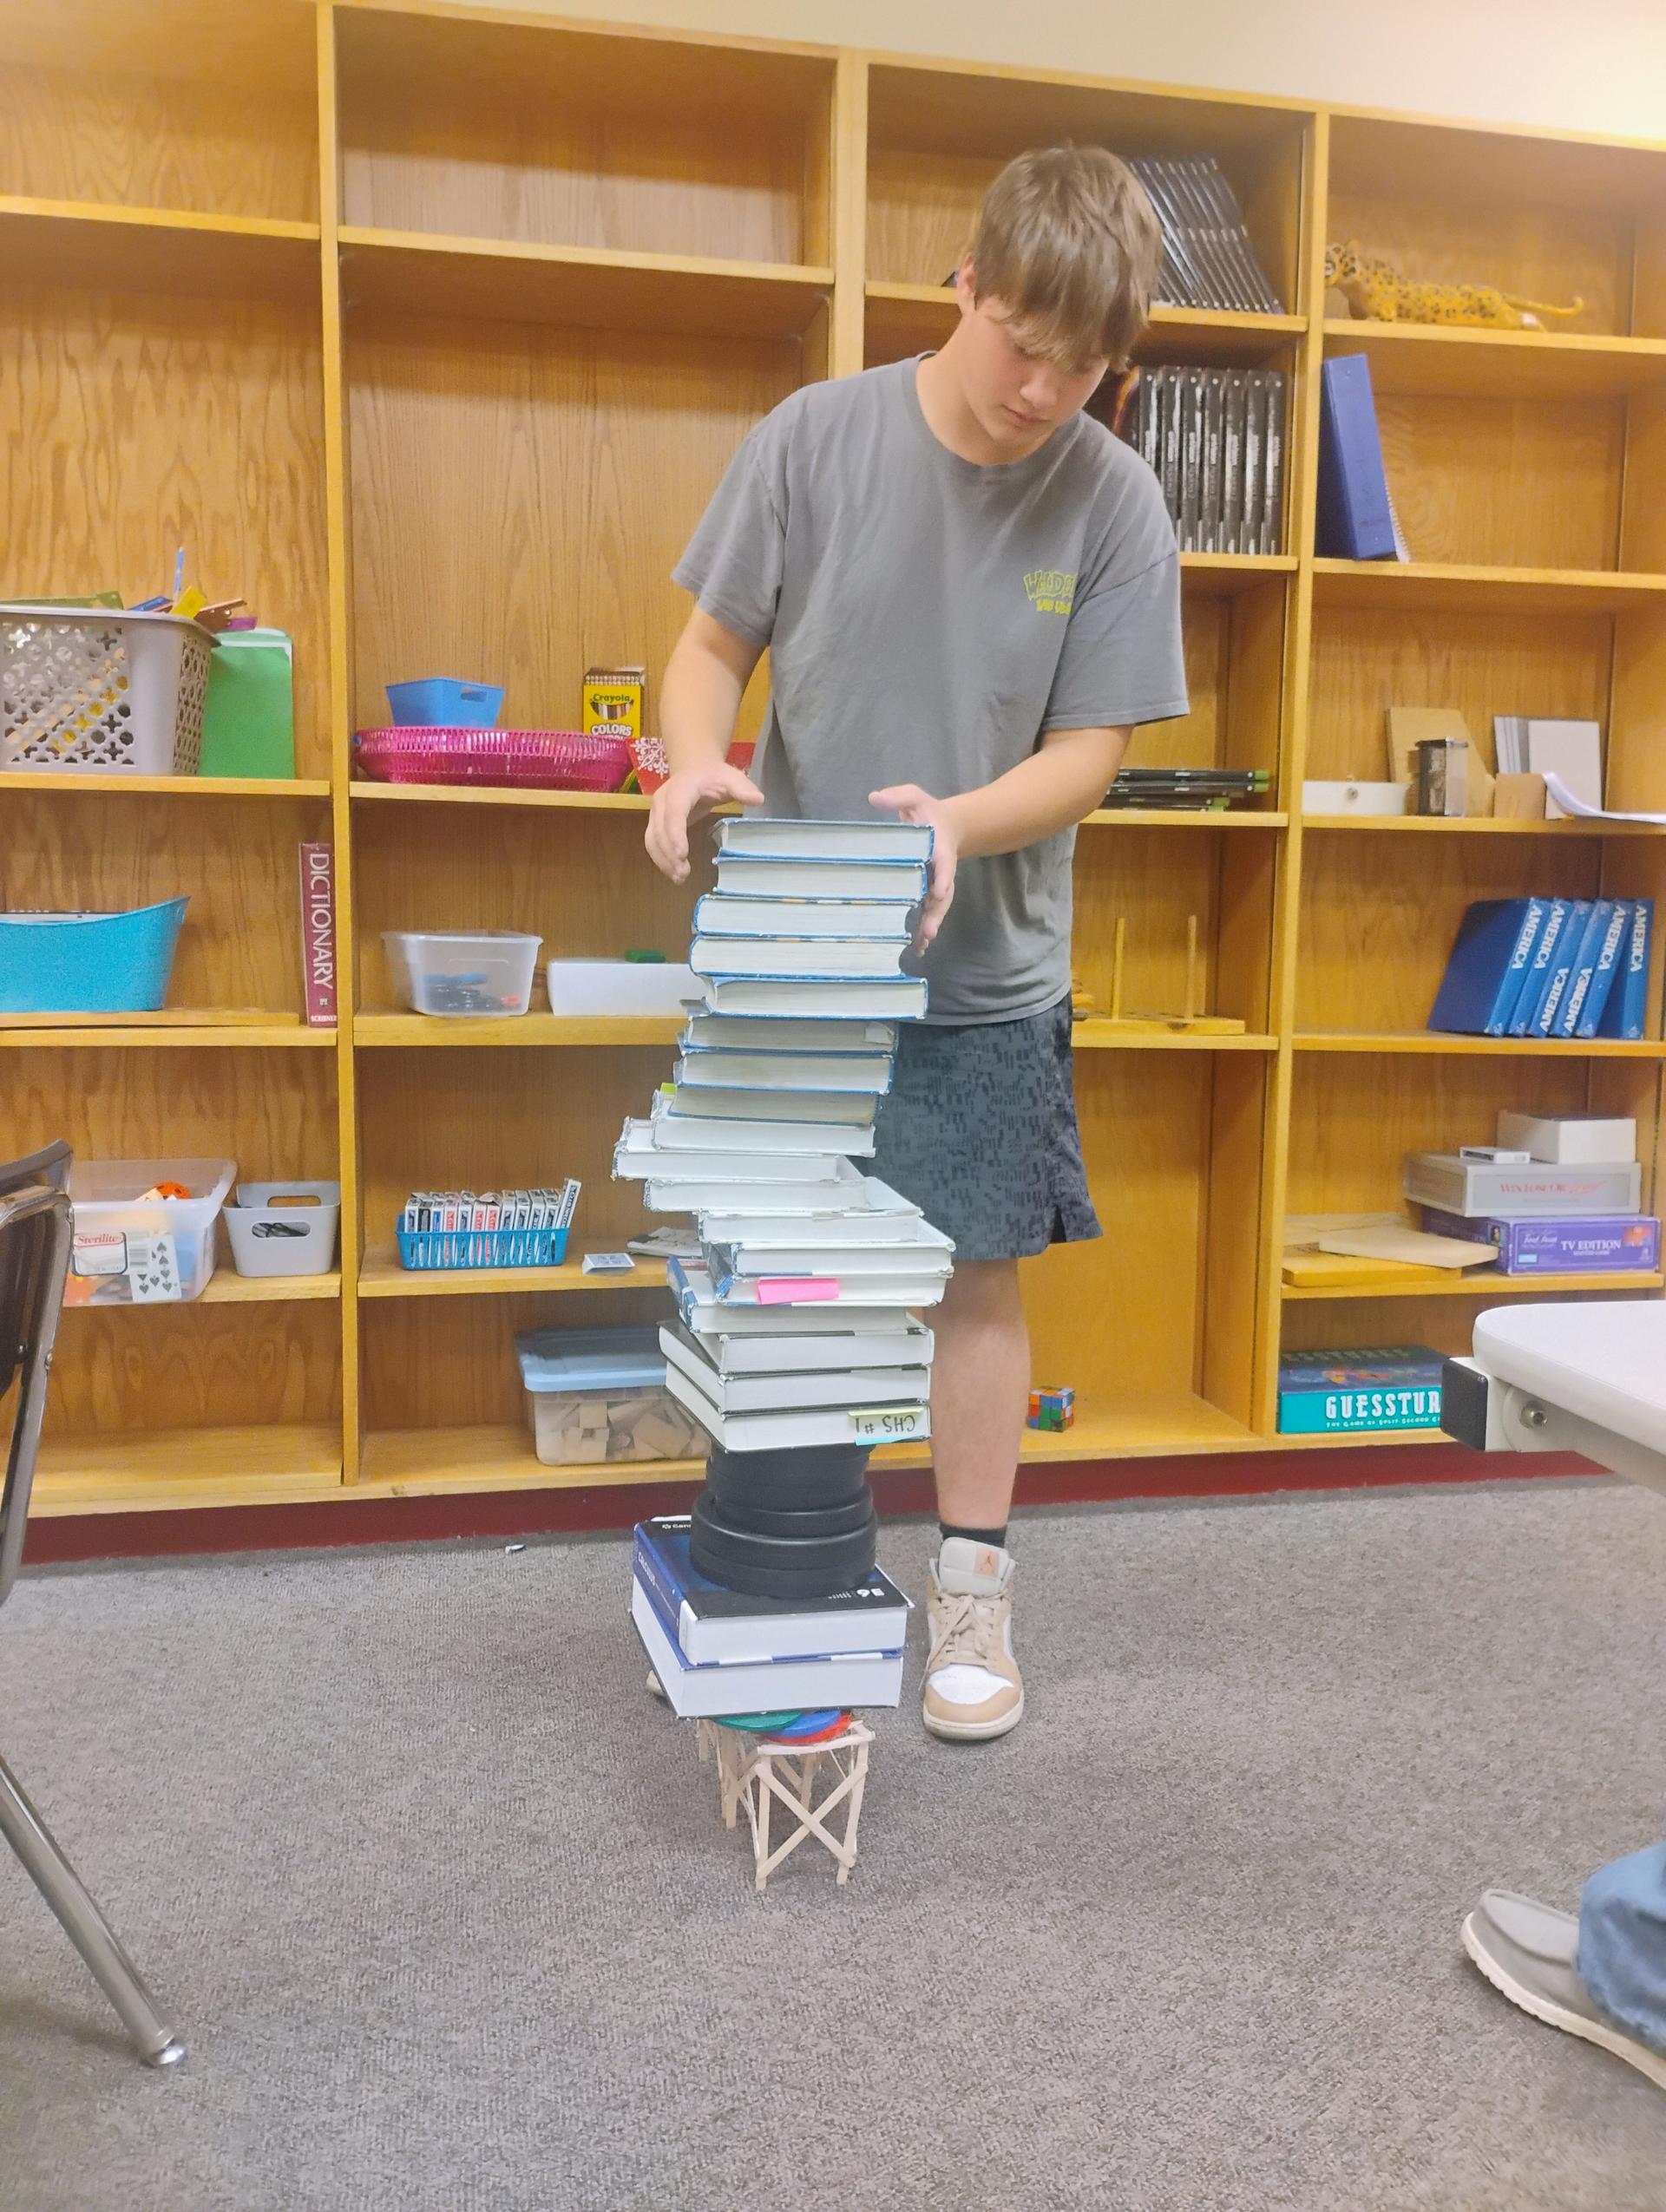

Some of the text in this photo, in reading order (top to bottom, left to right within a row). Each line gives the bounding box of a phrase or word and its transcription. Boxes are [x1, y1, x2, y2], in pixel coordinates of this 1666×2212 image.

[591, 723, 633, 736] COLORS
[593, 694, 630, 703] Crayola
[310, 854, 333, 990] DICTIONARY
[1512, 905, 1542, 969] AMERICA
[1533, 905, 1565, 969] AMERICA
[1597, 905, 1626, 971] AMERICA
[1630, 905, 1647, 972] AMERICA
[1539, 968, 1569, 1032] AMERICA
[1564, 968, 1592, 1032] AMERICA
[78, 1234, 116, 1244] Sterilite
[1561, 1240, 1622, 1251] TV EDITION
[882, 1415, 915, 1433] CHS
